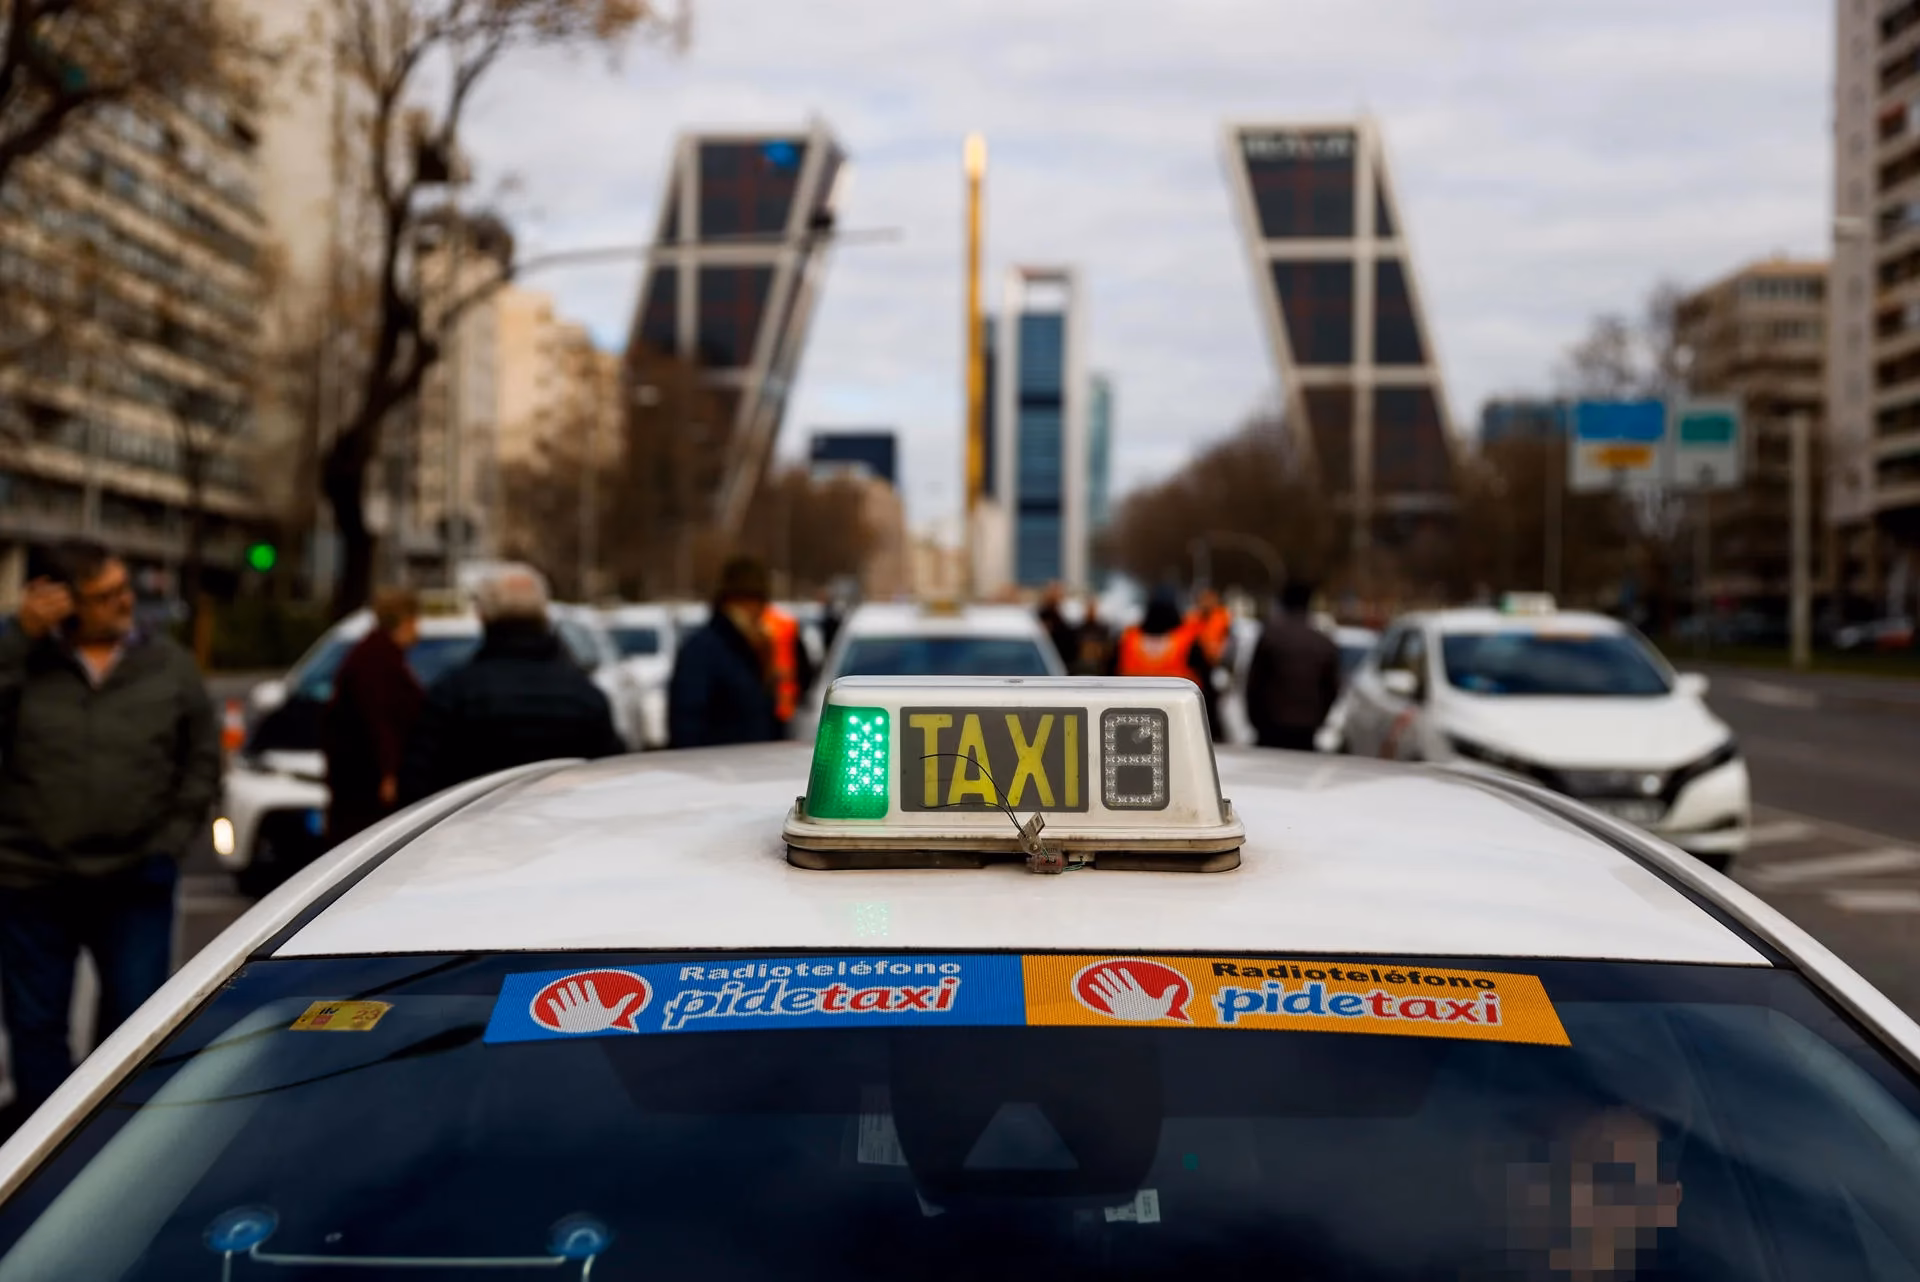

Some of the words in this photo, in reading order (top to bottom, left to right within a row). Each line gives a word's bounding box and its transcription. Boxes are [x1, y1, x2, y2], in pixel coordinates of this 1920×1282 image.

[909, 713, 1079, 807] TAXI
[679, 960, 962, 981] Radioteléfono
[1211, 962, 1496, 990] Radioteléfono
[662, 976, 961, 1030] pidetaxi
[1213, 980, 1502, 1025] pidetaxi
